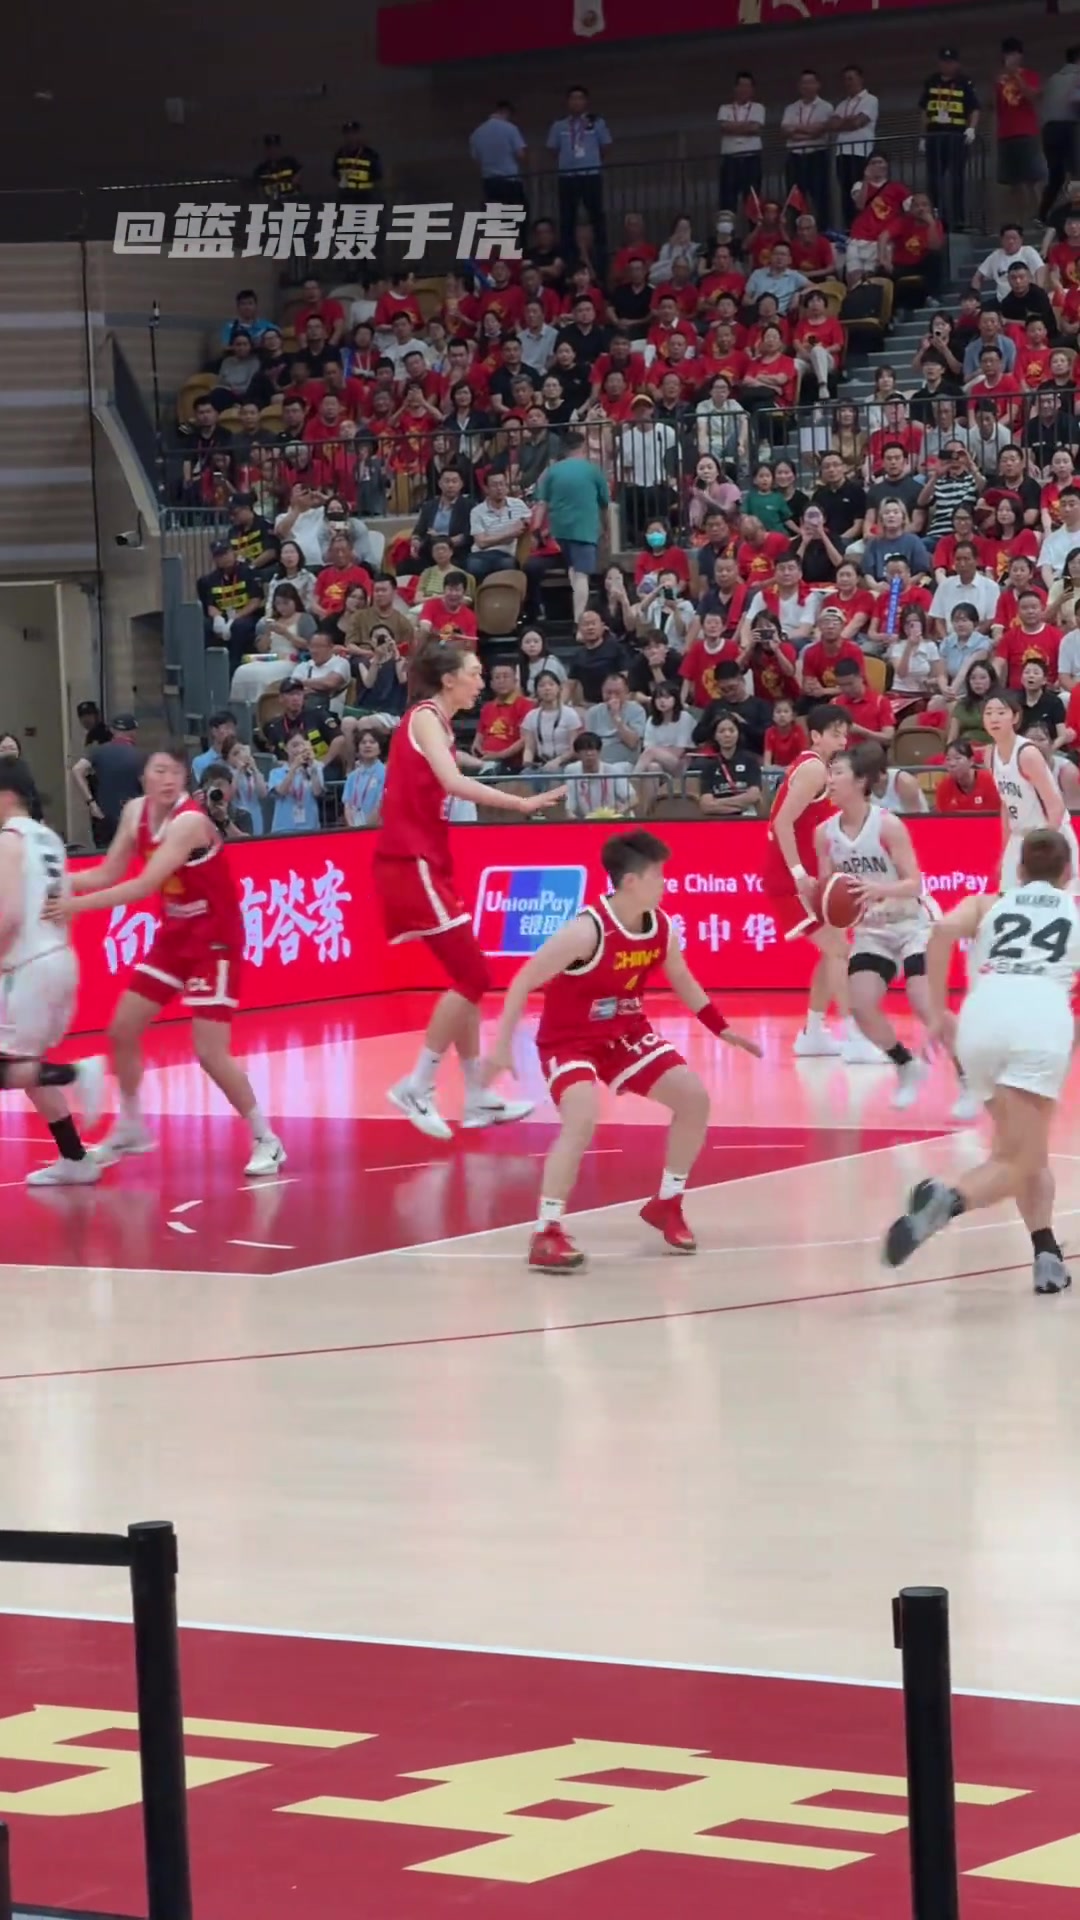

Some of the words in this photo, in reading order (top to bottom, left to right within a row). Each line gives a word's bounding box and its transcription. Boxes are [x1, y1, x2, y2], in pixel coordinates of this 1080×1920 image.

[684, 873, 738, 893] China
[485, 890, 575, 919] UnionPay
[989, 913, 1073, 963] 24
